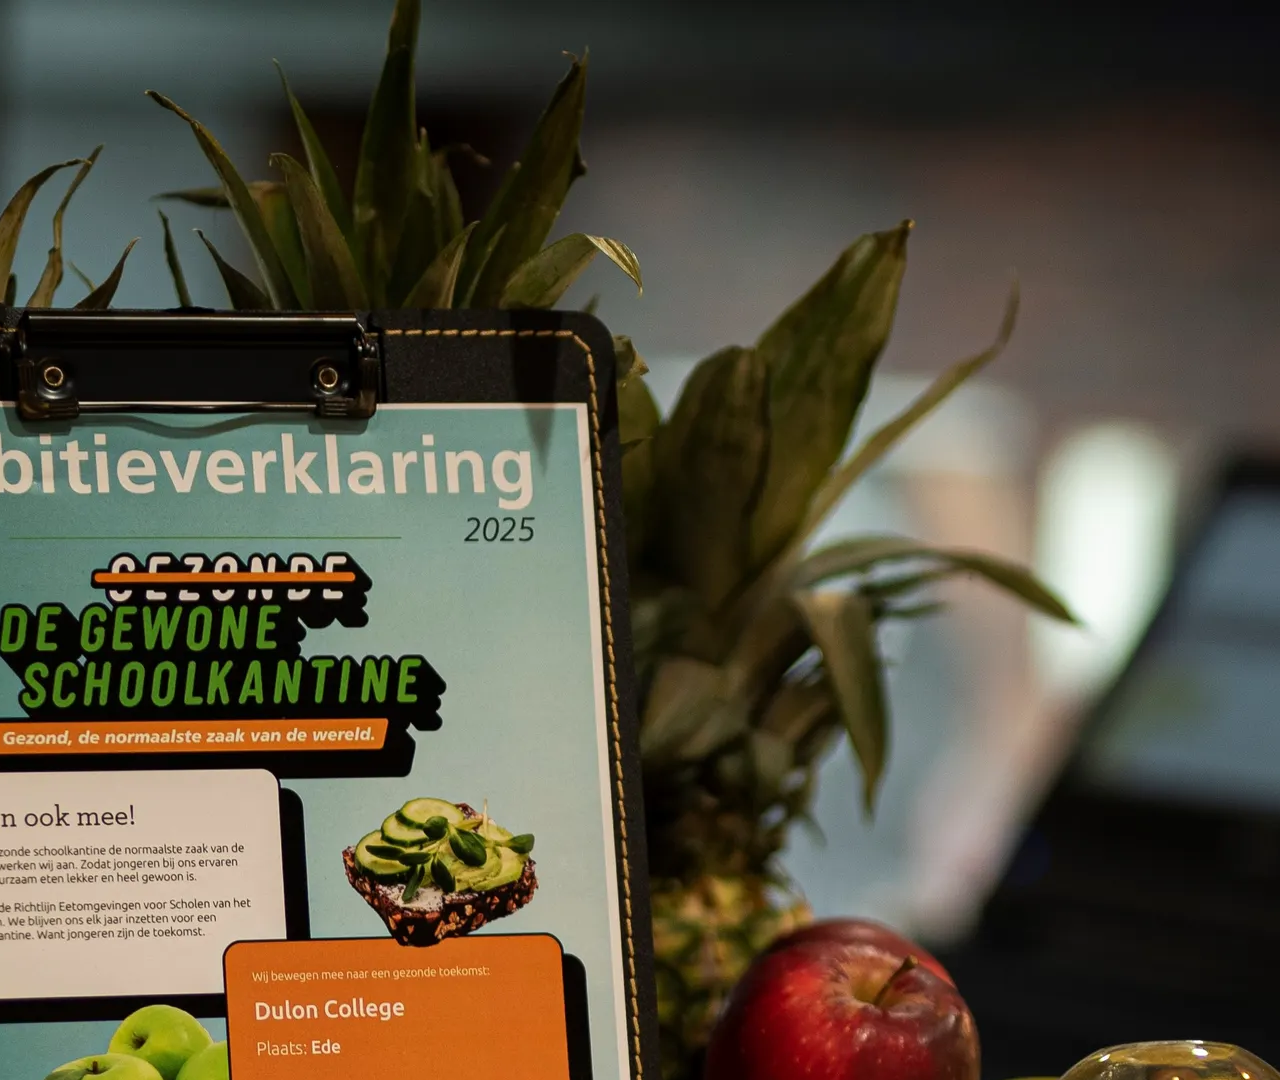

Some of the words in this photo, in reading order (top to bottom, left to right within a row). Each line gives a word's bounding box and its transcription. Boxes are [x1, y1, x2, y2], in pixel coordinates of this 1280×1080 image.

[463, 517, 535, 542] 2025
[108, 555, 347, 601] GEZONDE
[0, 607, 62, 652] DE
[80, 605, 281, 651] GEWONE
[21, 659, 421, 708] SCHOOLKANTINE
[3, 730, 72, 746] Gezond,
[78, 730, 99, 743] de
[104, 729, 202, 744] normaalste
[207, 728, 245, 742] zaak
[251, 731, 281, 742] van
[286, 728, 307, 742] de
[312, 727, 375, 741] wereld.
[24, 805, 70, 827] ook
[77, 805, 135, 826] mee!
[33, 845, 106, 856] schoolkantine
[109, 845, 122, 855] de
[125, 843, 182, 855] normaalste
[185, 843, 208, 853] zaak
[211, 845, 228, 853] van
[231, 842, 244, 853] de
[39, 860, 54, 872] wij
[56, 861, 78, 870] aan.
[81, 858, 111, 869] Zodat
[113, 859, 160, 872] jongeren
[163, 857, 175, 870] bij
[178, 859, 196, 868] ons
[199, 857, 238, 867] ervaren
[40, 874, 64, 883] eten
[67, 873, 98, 883] lekker
[101, 874, 114, 882] en
[117, 872, 139, 882] heel
[141, 873, 183, 884] gewoon
[186, 872, 197, 881] is.
[14, 901, 56, 914] Richtlijn
[59, 900, 141, 914] Eetomgevingen
[144, 901, 167, 910] voor
[170, 898, 210, 910] Scholen
[212, 900, 231, 909] van
[234, 898, 251, 908] het
[8, 916, 26, 926] We
[28, 915, 62, 928] blijven
[65, 916, 83, 924] ons
[86, 914, 102, 924] elk
[103, 914, 123, 926] jaar
[126, 913, 169, 923] inzetten
[171, 914, 194, 922] voor
[197, 913, 216, 921] een
[37, 929, 64, 940] Want
[66, 928, 114, 941] jongeren
[117, 928, 134, 940] zijn
[137, 927, 150, 937] de
[152, 926, 205, 937] toekomst.
[252, 971, 268, 983] Wij
[271, 970, 318, 983] bewegen
[322, 971, 344, 980] mee
[346, 970, 368, 979] naar
[371, 969, 390, 978] een
[393, 967, 436, 980] gezonde
[439, 966, 490, 977] toekomst:
[255, 1000, 318, 1021] Dulon
[324, 998, 405, 1021] College
[257, 1040, 307, 1056] Plaats:
[311, 1040, 341, 1054] Ede
